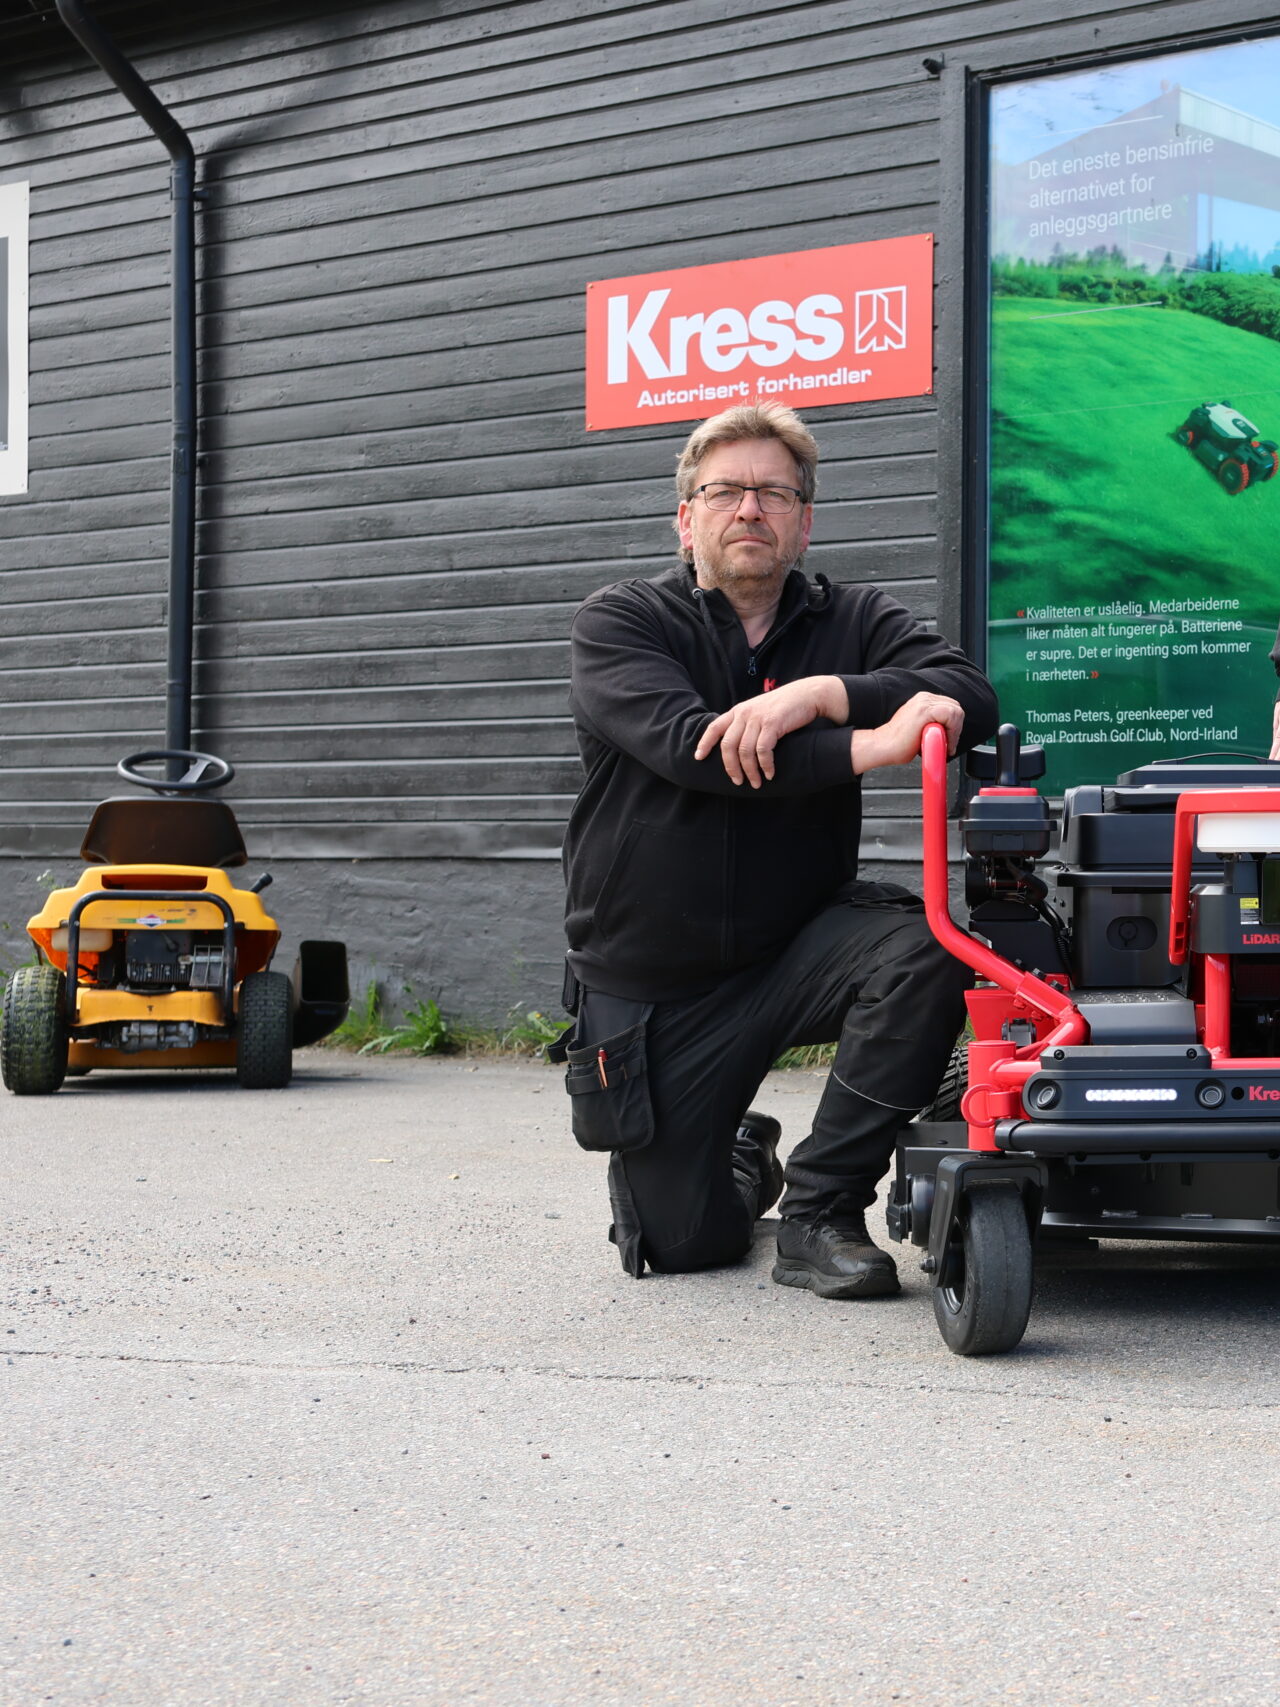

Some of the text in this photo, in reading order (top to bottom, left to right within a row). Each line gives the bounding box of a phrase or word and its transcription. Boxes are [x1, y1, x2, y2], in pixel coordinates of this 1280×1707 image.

[1029, 135, 1215, 180] Det eneste bensinfrie
[1029, 173, 1155, 209] alternativet for
[1029, 203, 1173, 238] anleggsgartnere
[607, 289, 844, 385] Kress
[637, 367, 872, 408] Autorisert forhandler
[1084, 606, 1097, 618] er
[1098, 601, 1146, 620] uslåelig.
[1149, 597, 1240, 614] Medarbeiderne
[1026, 619, 1243, 642] liker måten alt fungerer på. Batteriene
[1026, 640, 1251, 663] er supre. Det er ingenting som kommer
[1026, 669, 1030, 682] i
[1026, 705, 1213, 724] Thomas Peters, greenkeeper ved
[1026, 726, 1238, 747] Royal Portrush Golf Club, Nord-Irland
